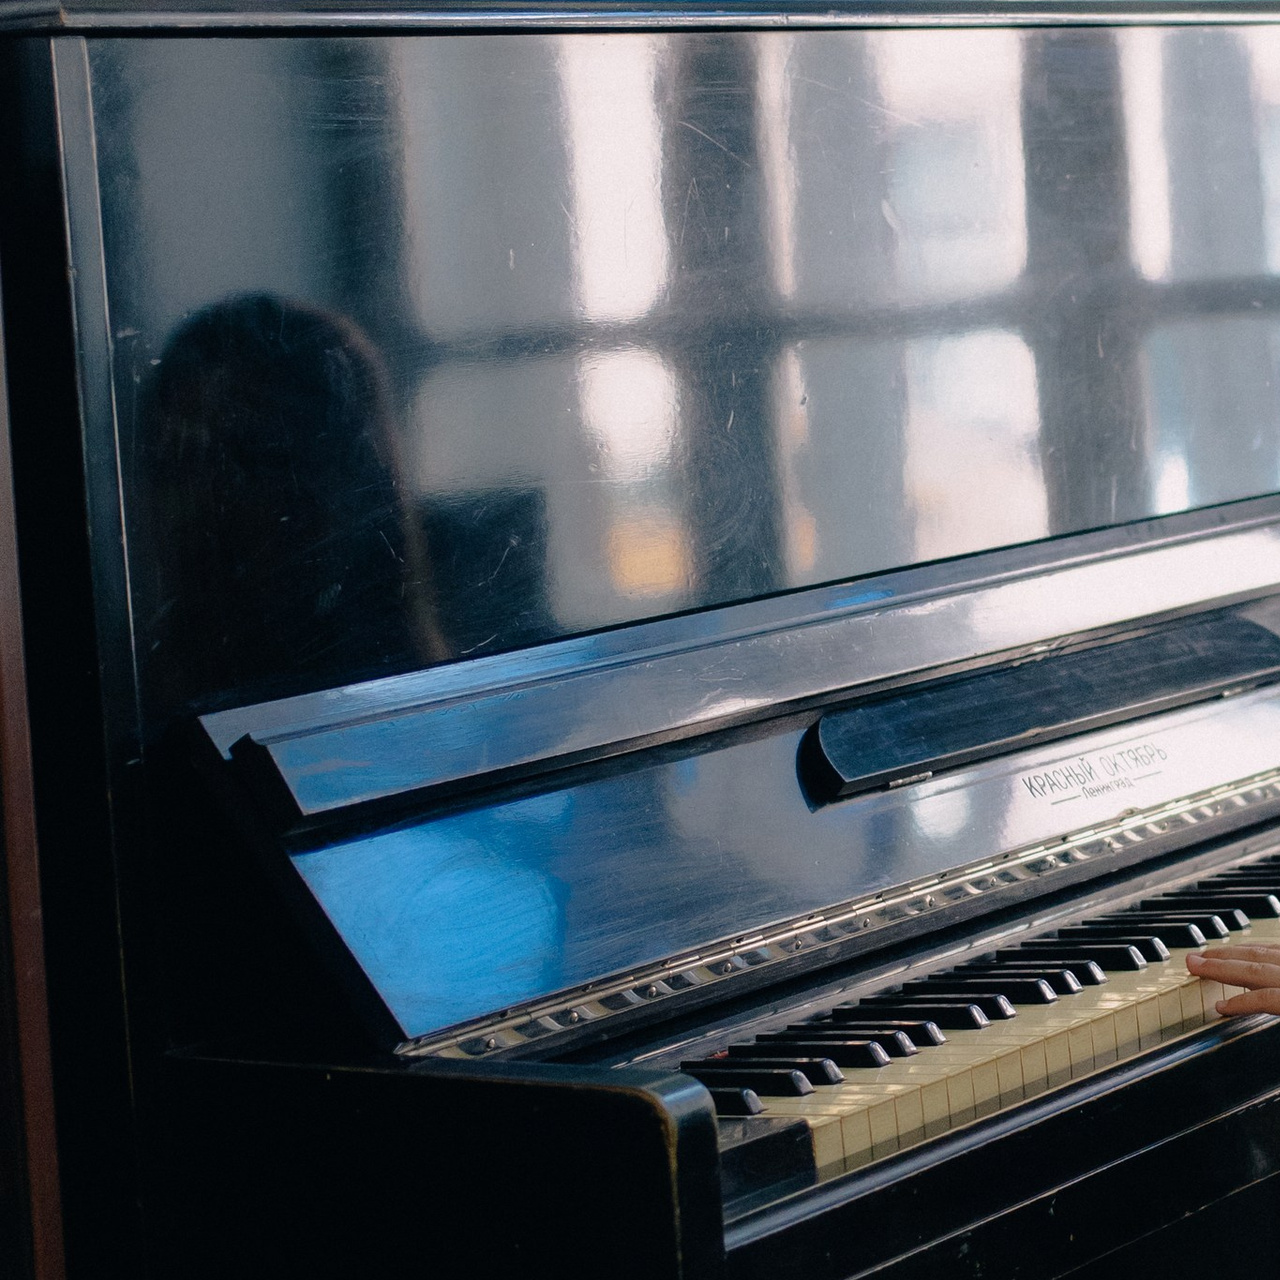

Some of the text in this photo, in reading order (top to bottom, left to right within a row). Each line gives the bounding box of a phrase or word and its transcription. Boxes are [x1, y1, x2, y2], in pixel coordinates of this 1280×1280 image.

[1021, 742, 1167, 798] КРАСНЫЙ ОКТЯБРЬ
[1081, 777, 1135, 800] Ленинград
